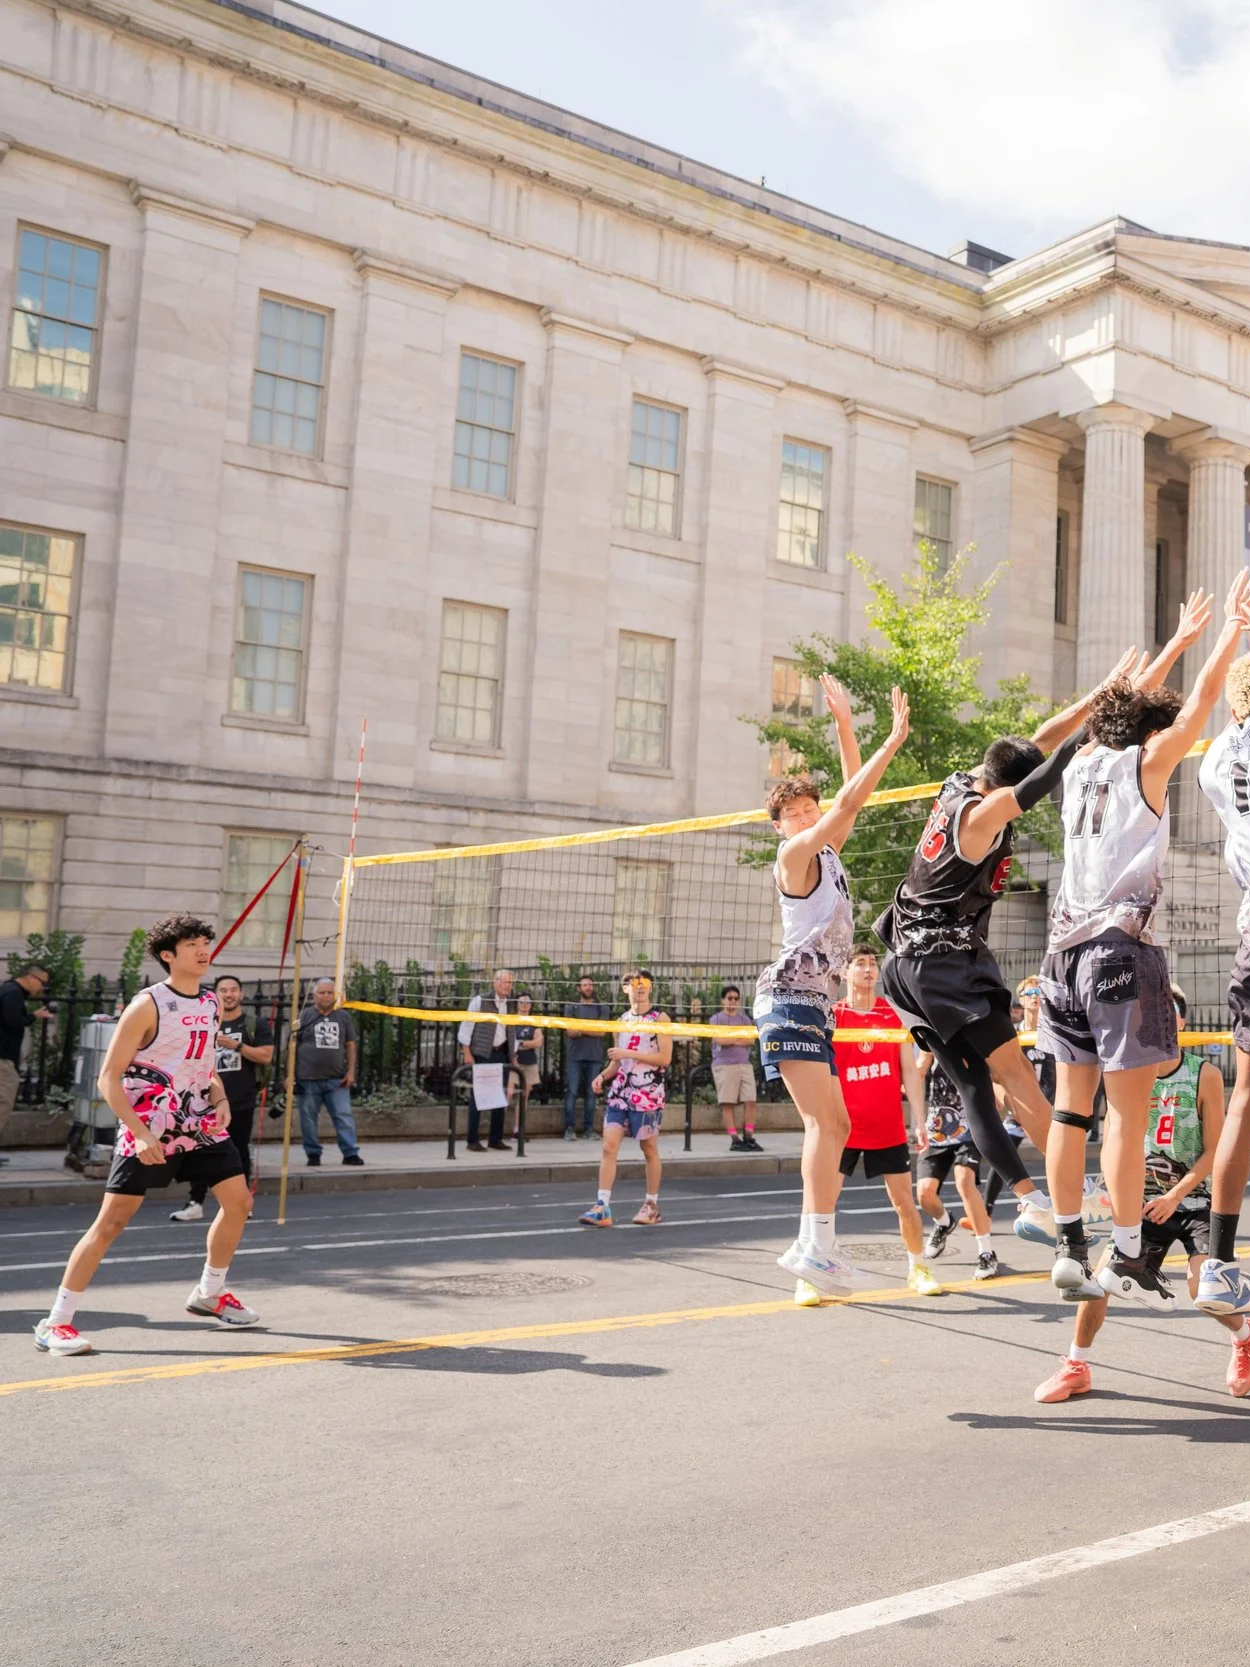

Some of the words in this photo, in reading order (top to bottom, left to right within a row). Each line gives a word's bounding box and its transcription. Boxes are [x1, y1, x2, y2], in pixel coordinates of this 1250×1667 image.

[1070, 779, 1114, 839] 11
[181, 1015, 209, 1026] CYC
[184, 1030, 209, 1060] 11
[762, 1042, 781, 1052] UC
[782, 1041, 821, 1053] IRVINE
